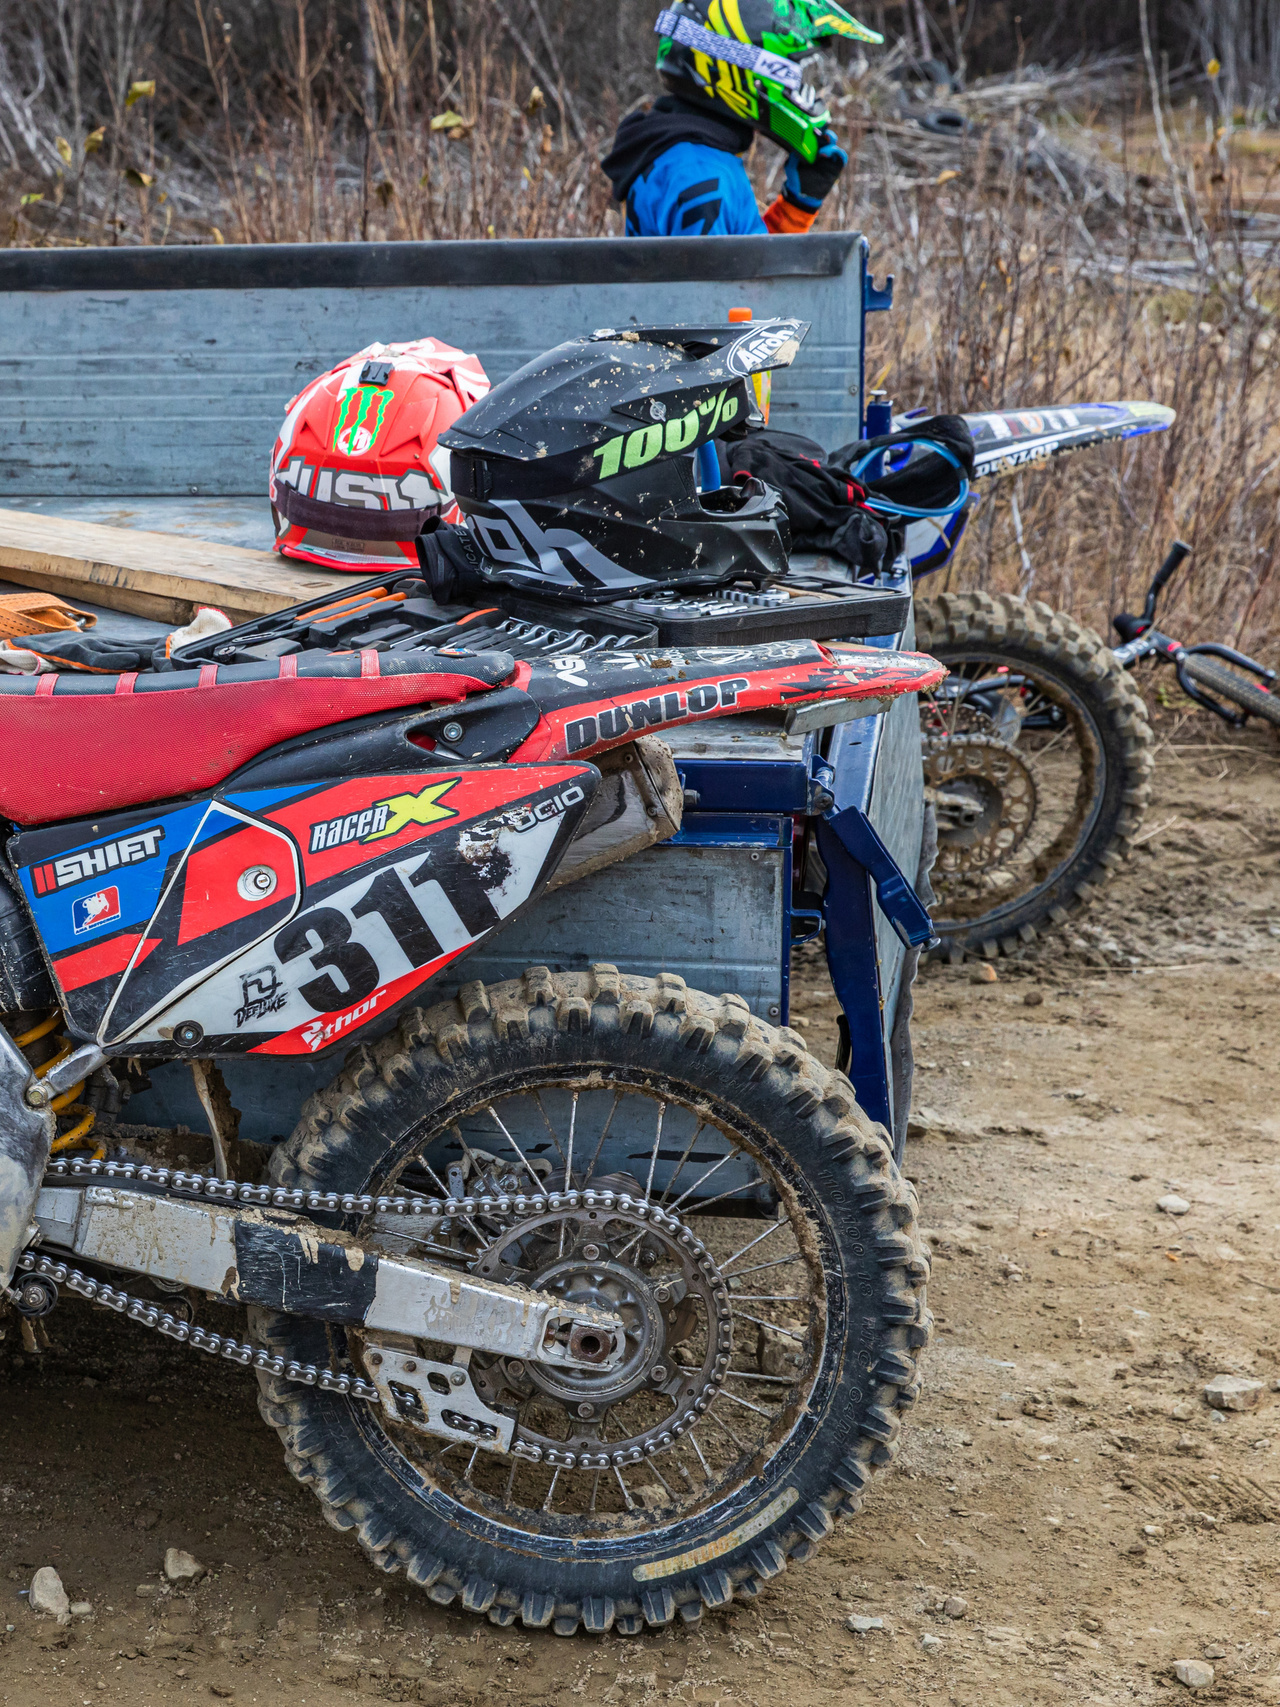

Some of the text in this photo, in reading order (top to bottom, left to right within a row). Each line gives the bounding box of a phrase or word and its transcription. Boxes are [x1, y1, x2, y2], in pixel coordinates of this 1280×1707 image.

[594, 388, 739, 480] 100%
[566, 678, 750, 755] DUNLOP
[55, 829, 163, 887] SHIFT
[273, 851, 500, 1013] 311
[326, 989, 387, 1038] thor
